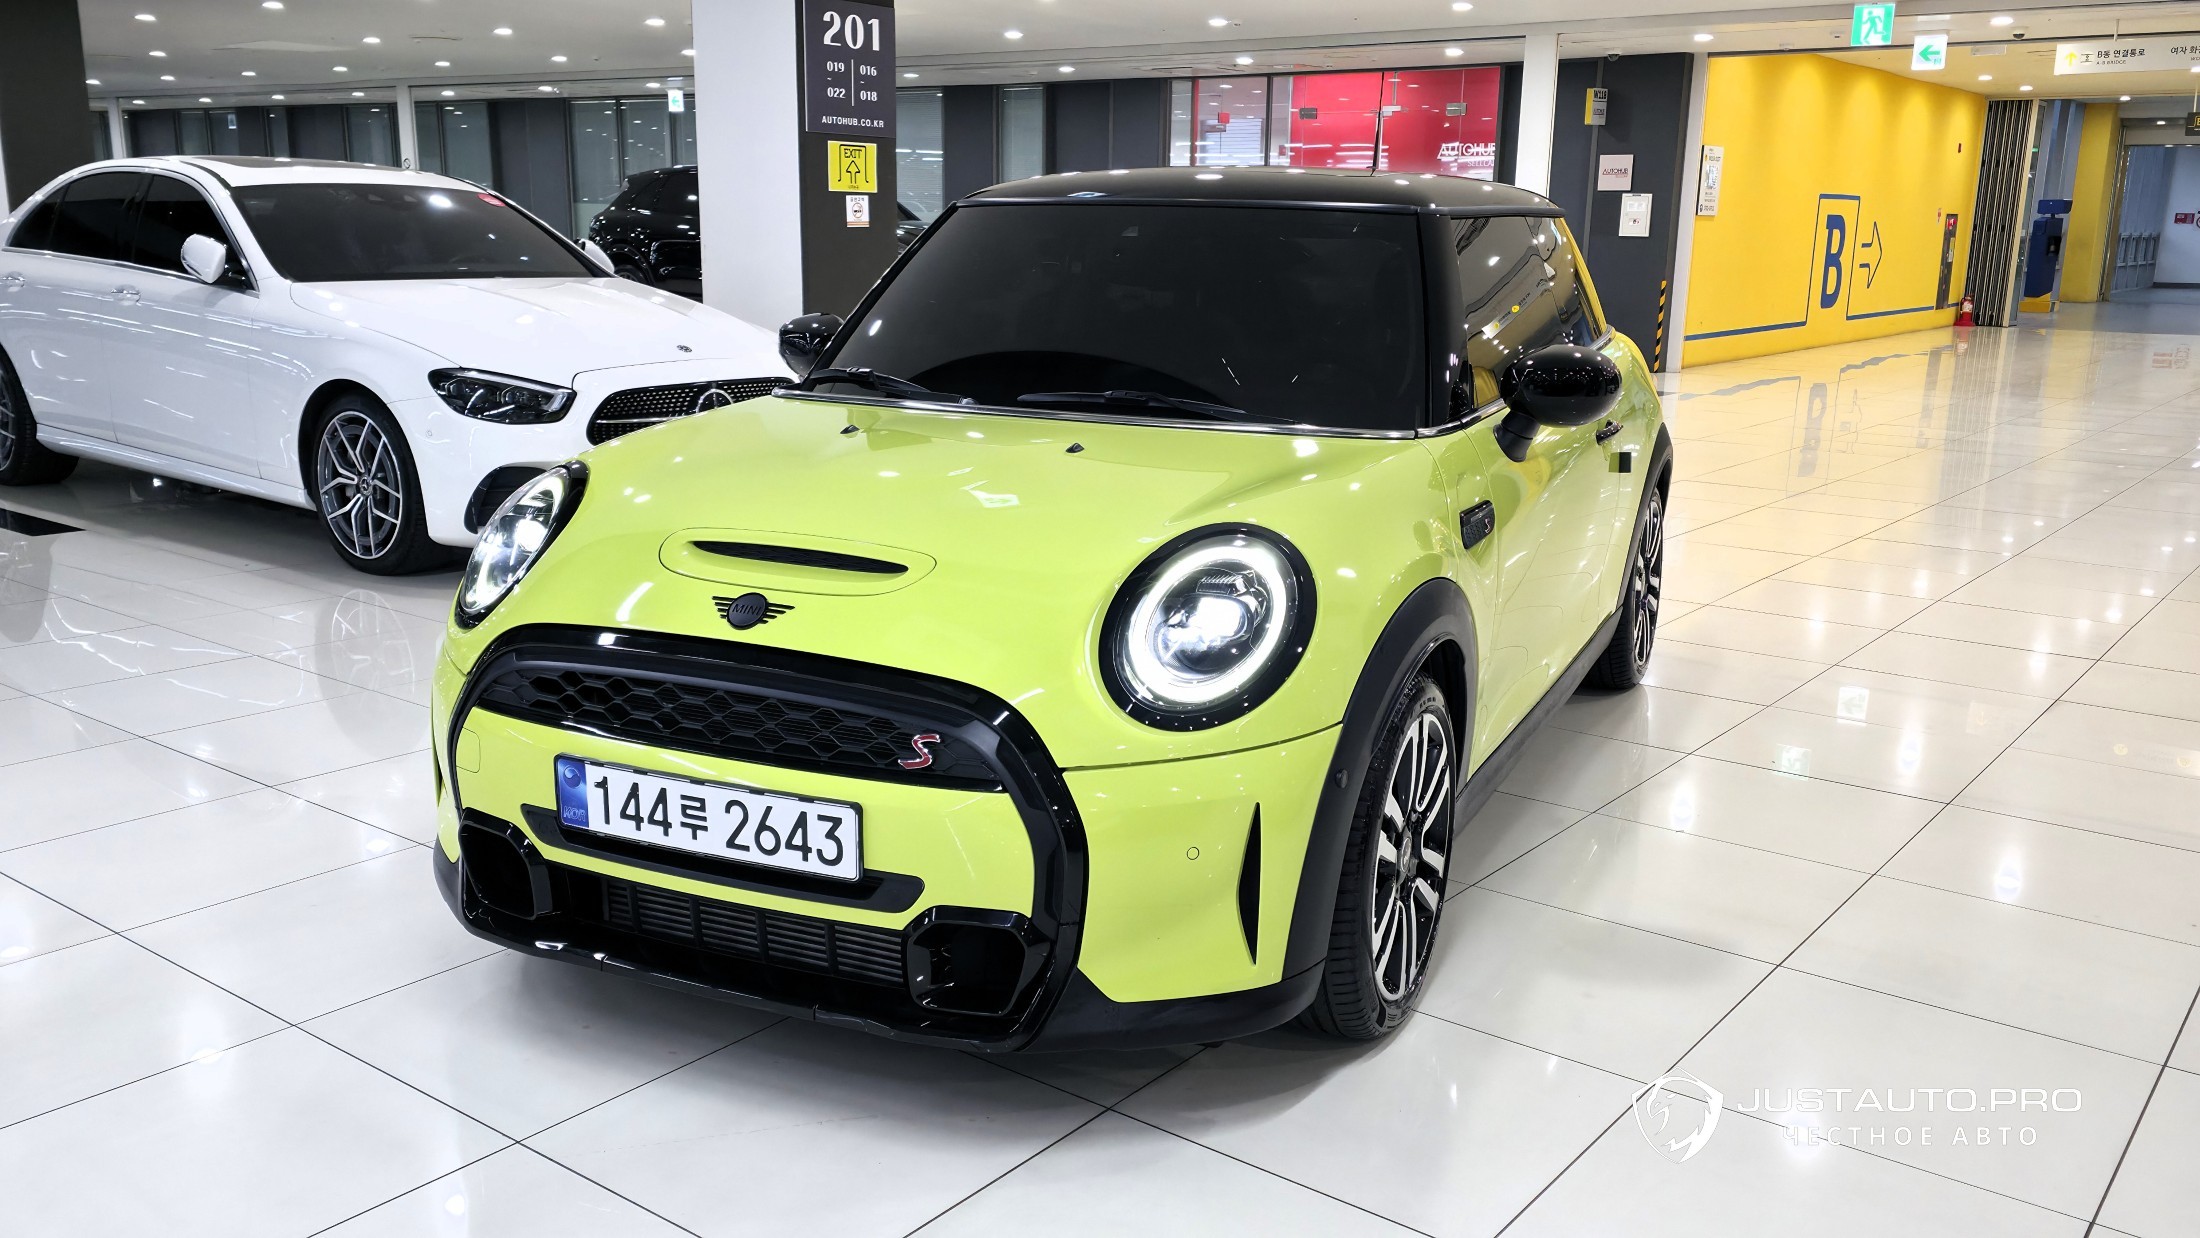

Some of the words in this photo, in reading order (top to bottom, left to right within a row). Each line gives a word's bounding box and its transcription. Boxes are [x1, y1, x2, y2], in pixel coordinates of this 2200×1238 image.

[823, 11, 880, 51] 201
[2170, 46, 2187, 55] 여자
[826, 61, 845, 72] 019
[859, 65, 877, 76] 016
[827, 87, 846, 98] 022
[860, 90, 878, 101] 018
[821, 115, 885, 128] AUTOHUB.CO.KR
[844, 148, 862, 159] EXIT
[1820, 214, 1846, 309] B
[732, 603, 762, 616] MINI
[898, 733, 941, 769] S
[563, 805, 586, 822] KOR
[594, 776, 709, 840] 144루
[724, 799, 844, 867] 2643
